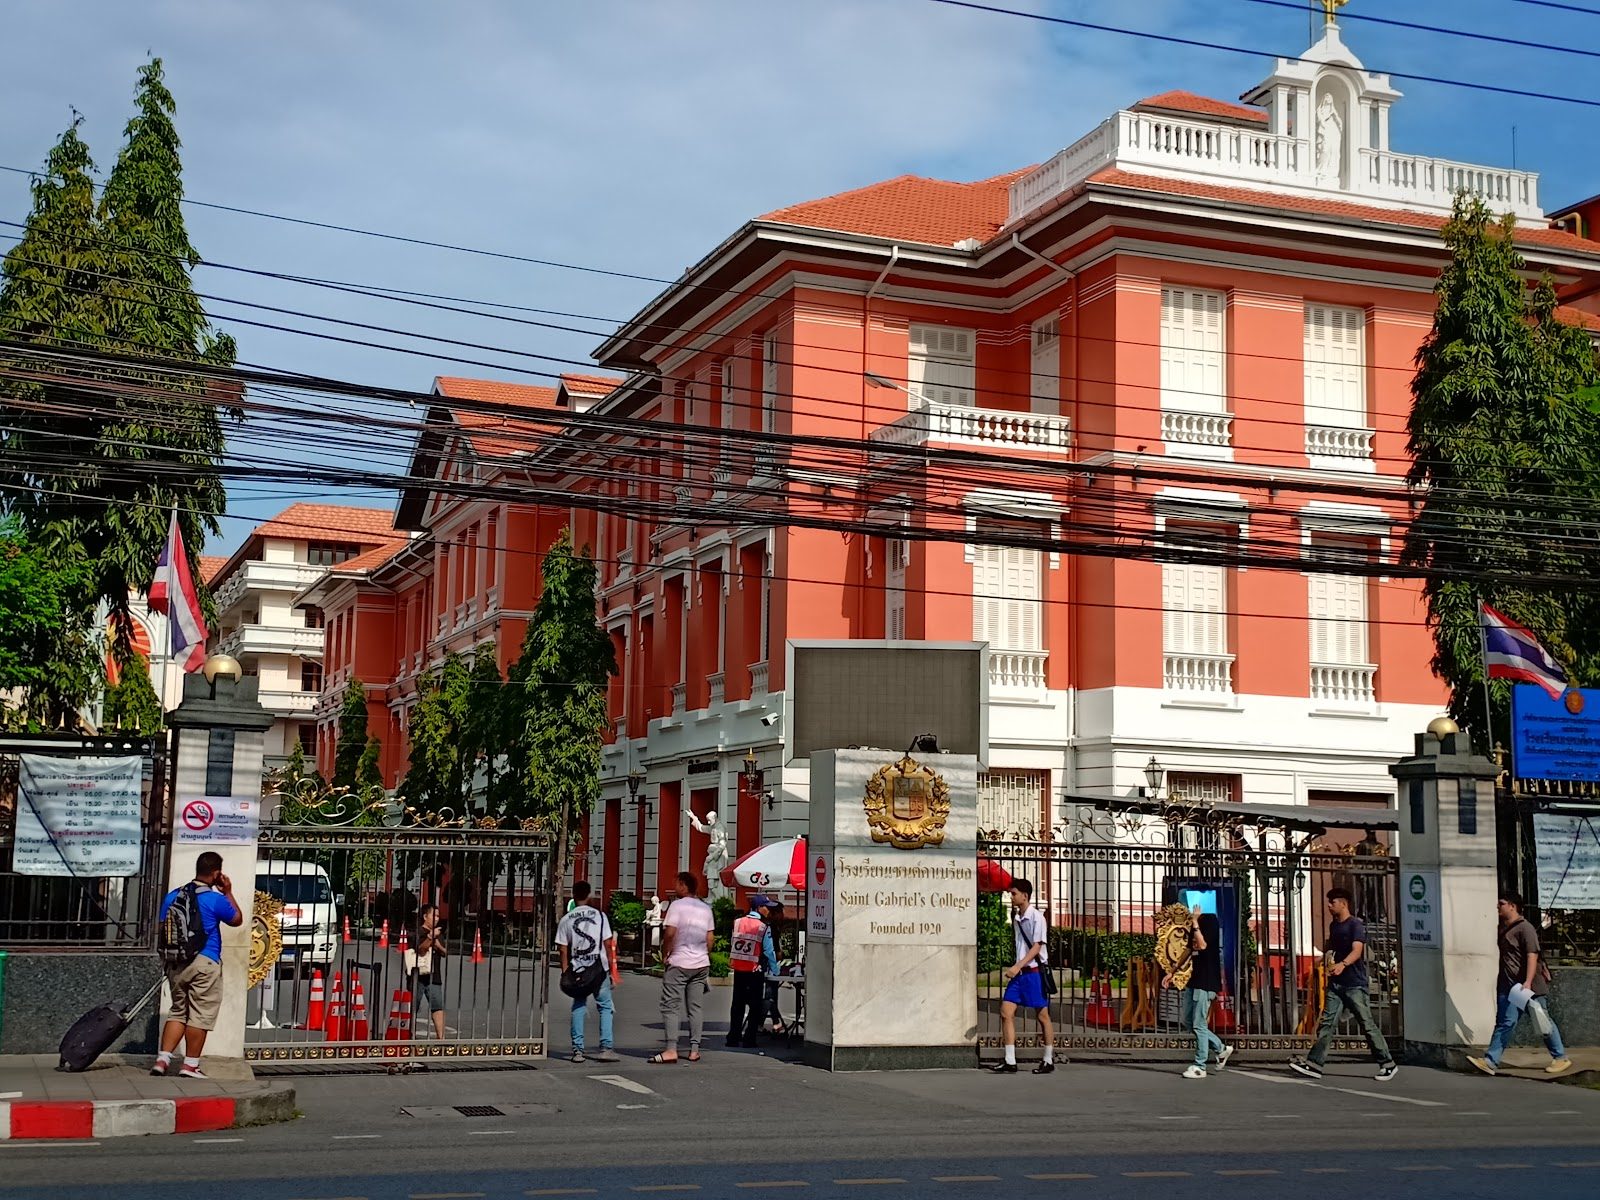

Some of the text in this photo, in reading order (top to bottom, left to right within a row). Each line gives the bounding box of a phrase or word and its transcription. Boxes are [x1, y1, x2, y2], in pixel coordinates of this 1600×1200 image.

[840, 890, 971, 912] Saint Gabriel's College
[815, 905, 825, 917] OUT
[870, 921, 942, 936] Founded 1920
[1414, 919, 1425, 930] IN
